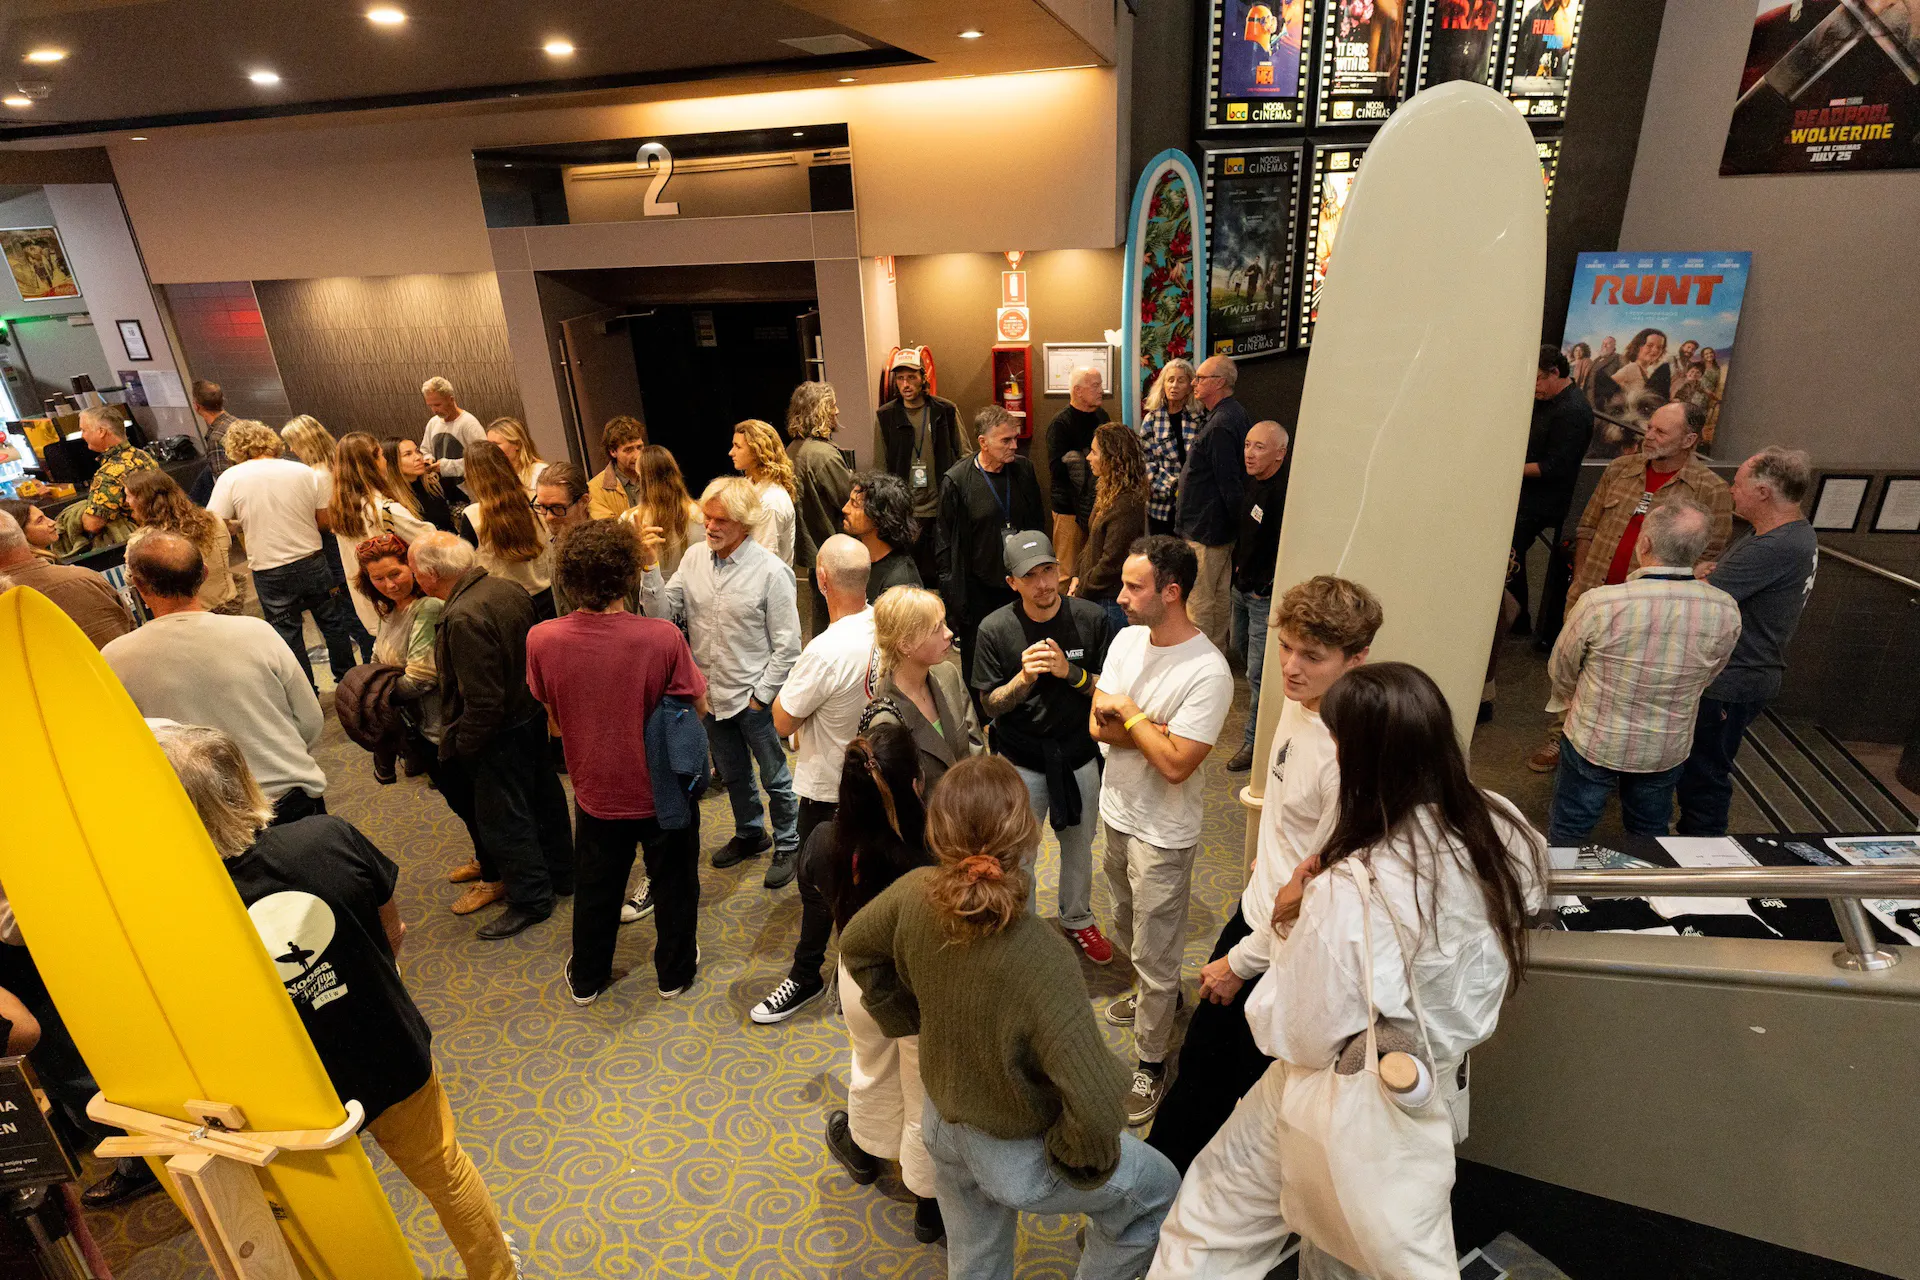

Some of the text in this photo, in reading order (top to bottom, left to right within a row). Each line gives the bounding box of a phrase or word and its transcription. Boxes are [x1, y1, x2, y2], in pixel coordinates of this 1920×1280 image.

[1346, 42, 1369, 57] ENDS
[1336, 57, 1370, 71] WITH US
[1263, 102, 1285, 111] NOOSA
[1366, 101, 1385, 109] NOOSA
[1530, 105, 1558, 115] CINEMAS
[1252, 110, 1292, 121] CINEMAS
[1356, 108, 1390, 118] CINEMAS
[1794, 103, 1890, 128] DEADPOOL
[1791, 123, 1894, 144] WOLVERINE
[1260, 155, 1280, 163] NOOSA
[1810, 151, 1853, 162] JULY 25
[1224, 157, 1243, 173] bcc
[1249, 162, 1288, 174] CINEMAS
[636, 142, 680, 216] 2
[1591, 275, 1724, 306] RUNT
[1219, 301, 1275, 316] TWISTERS
[1248, 334, 1266, 343] NOOSA
[1237, 339, 1273, 353] CINEMAS
[1065, 648, 1084, 658] VANS
[287, 962, 333, 995] Noosa
[319, 991, 340, 1002] CREW
